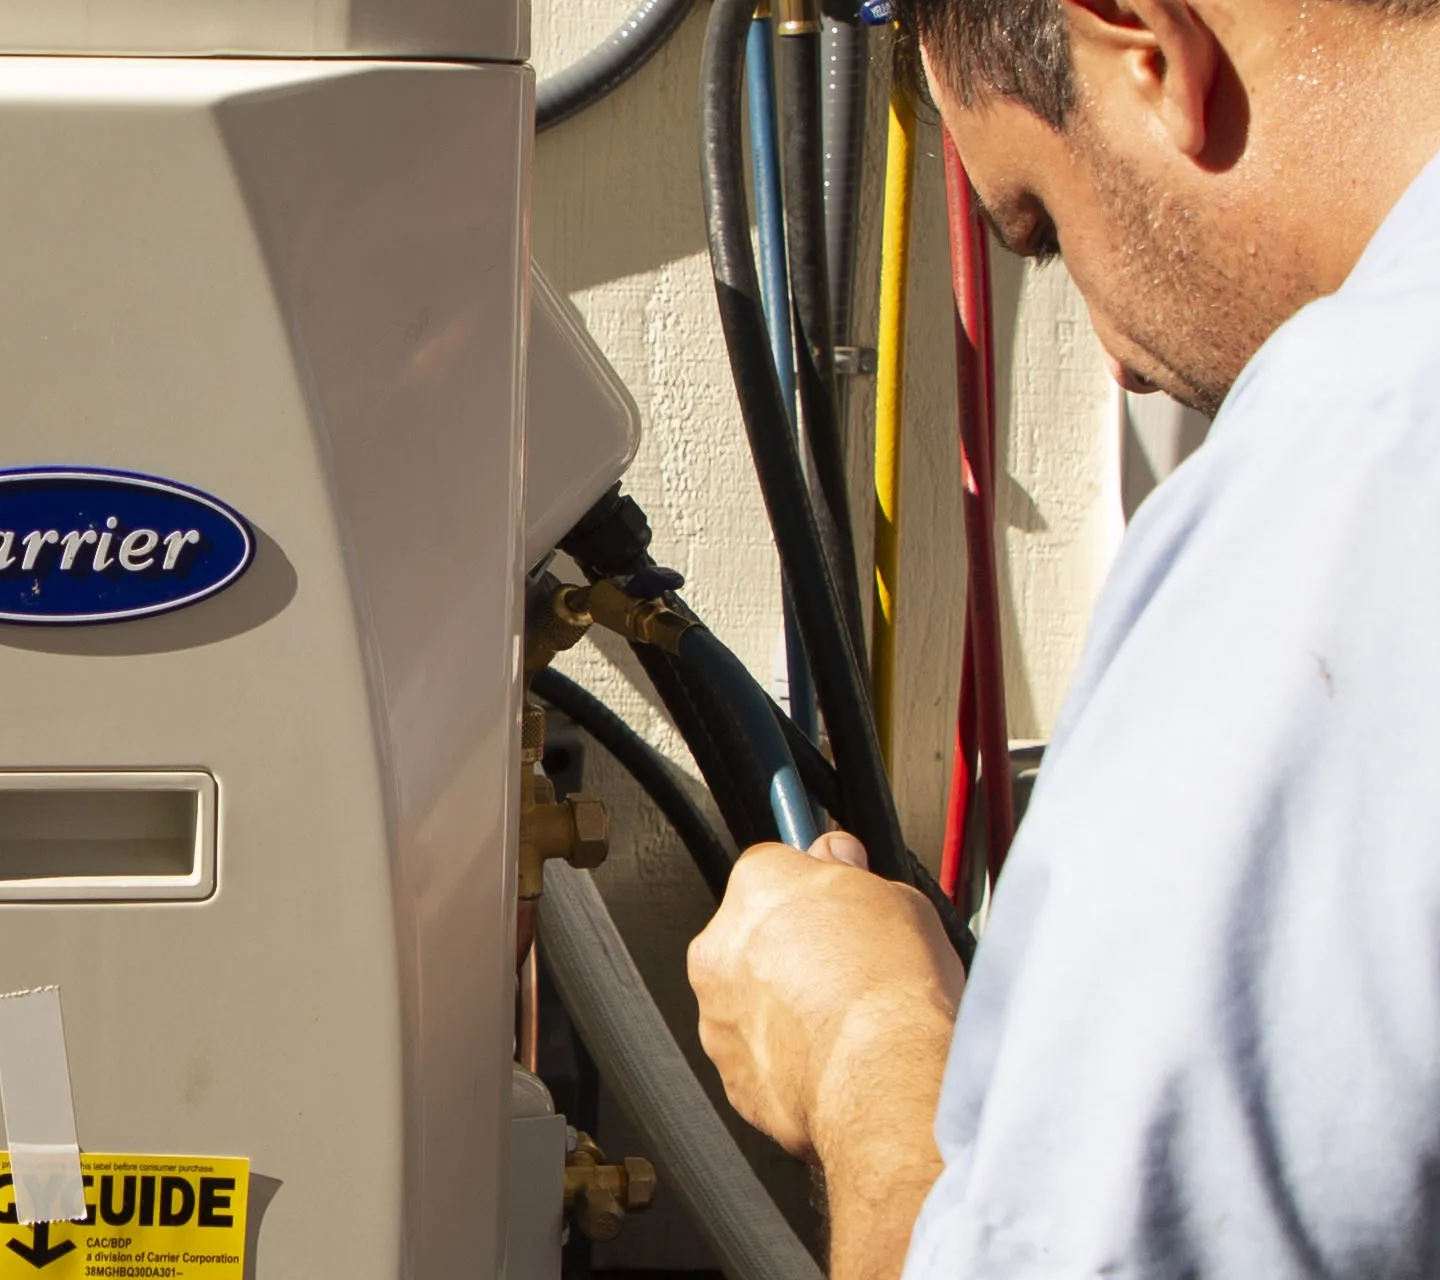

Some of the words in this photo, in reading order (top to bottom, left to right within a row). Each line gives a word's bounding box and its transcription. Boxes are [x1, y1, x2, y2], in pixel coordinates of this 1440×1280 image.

[93, 1162, 112, 1171] label
[113, 1163, 138, 1171] before
[178, 1164, 215, 1173] purchase.
[87, 1237, 132, 1249] CAC/BDP
[95, 1252, 132, 1262] division
[135, 1252, 145, 1262] of
[148, 1252, 180, 1263] Carrier
[182, 1253, 239, 1265] Corporation
